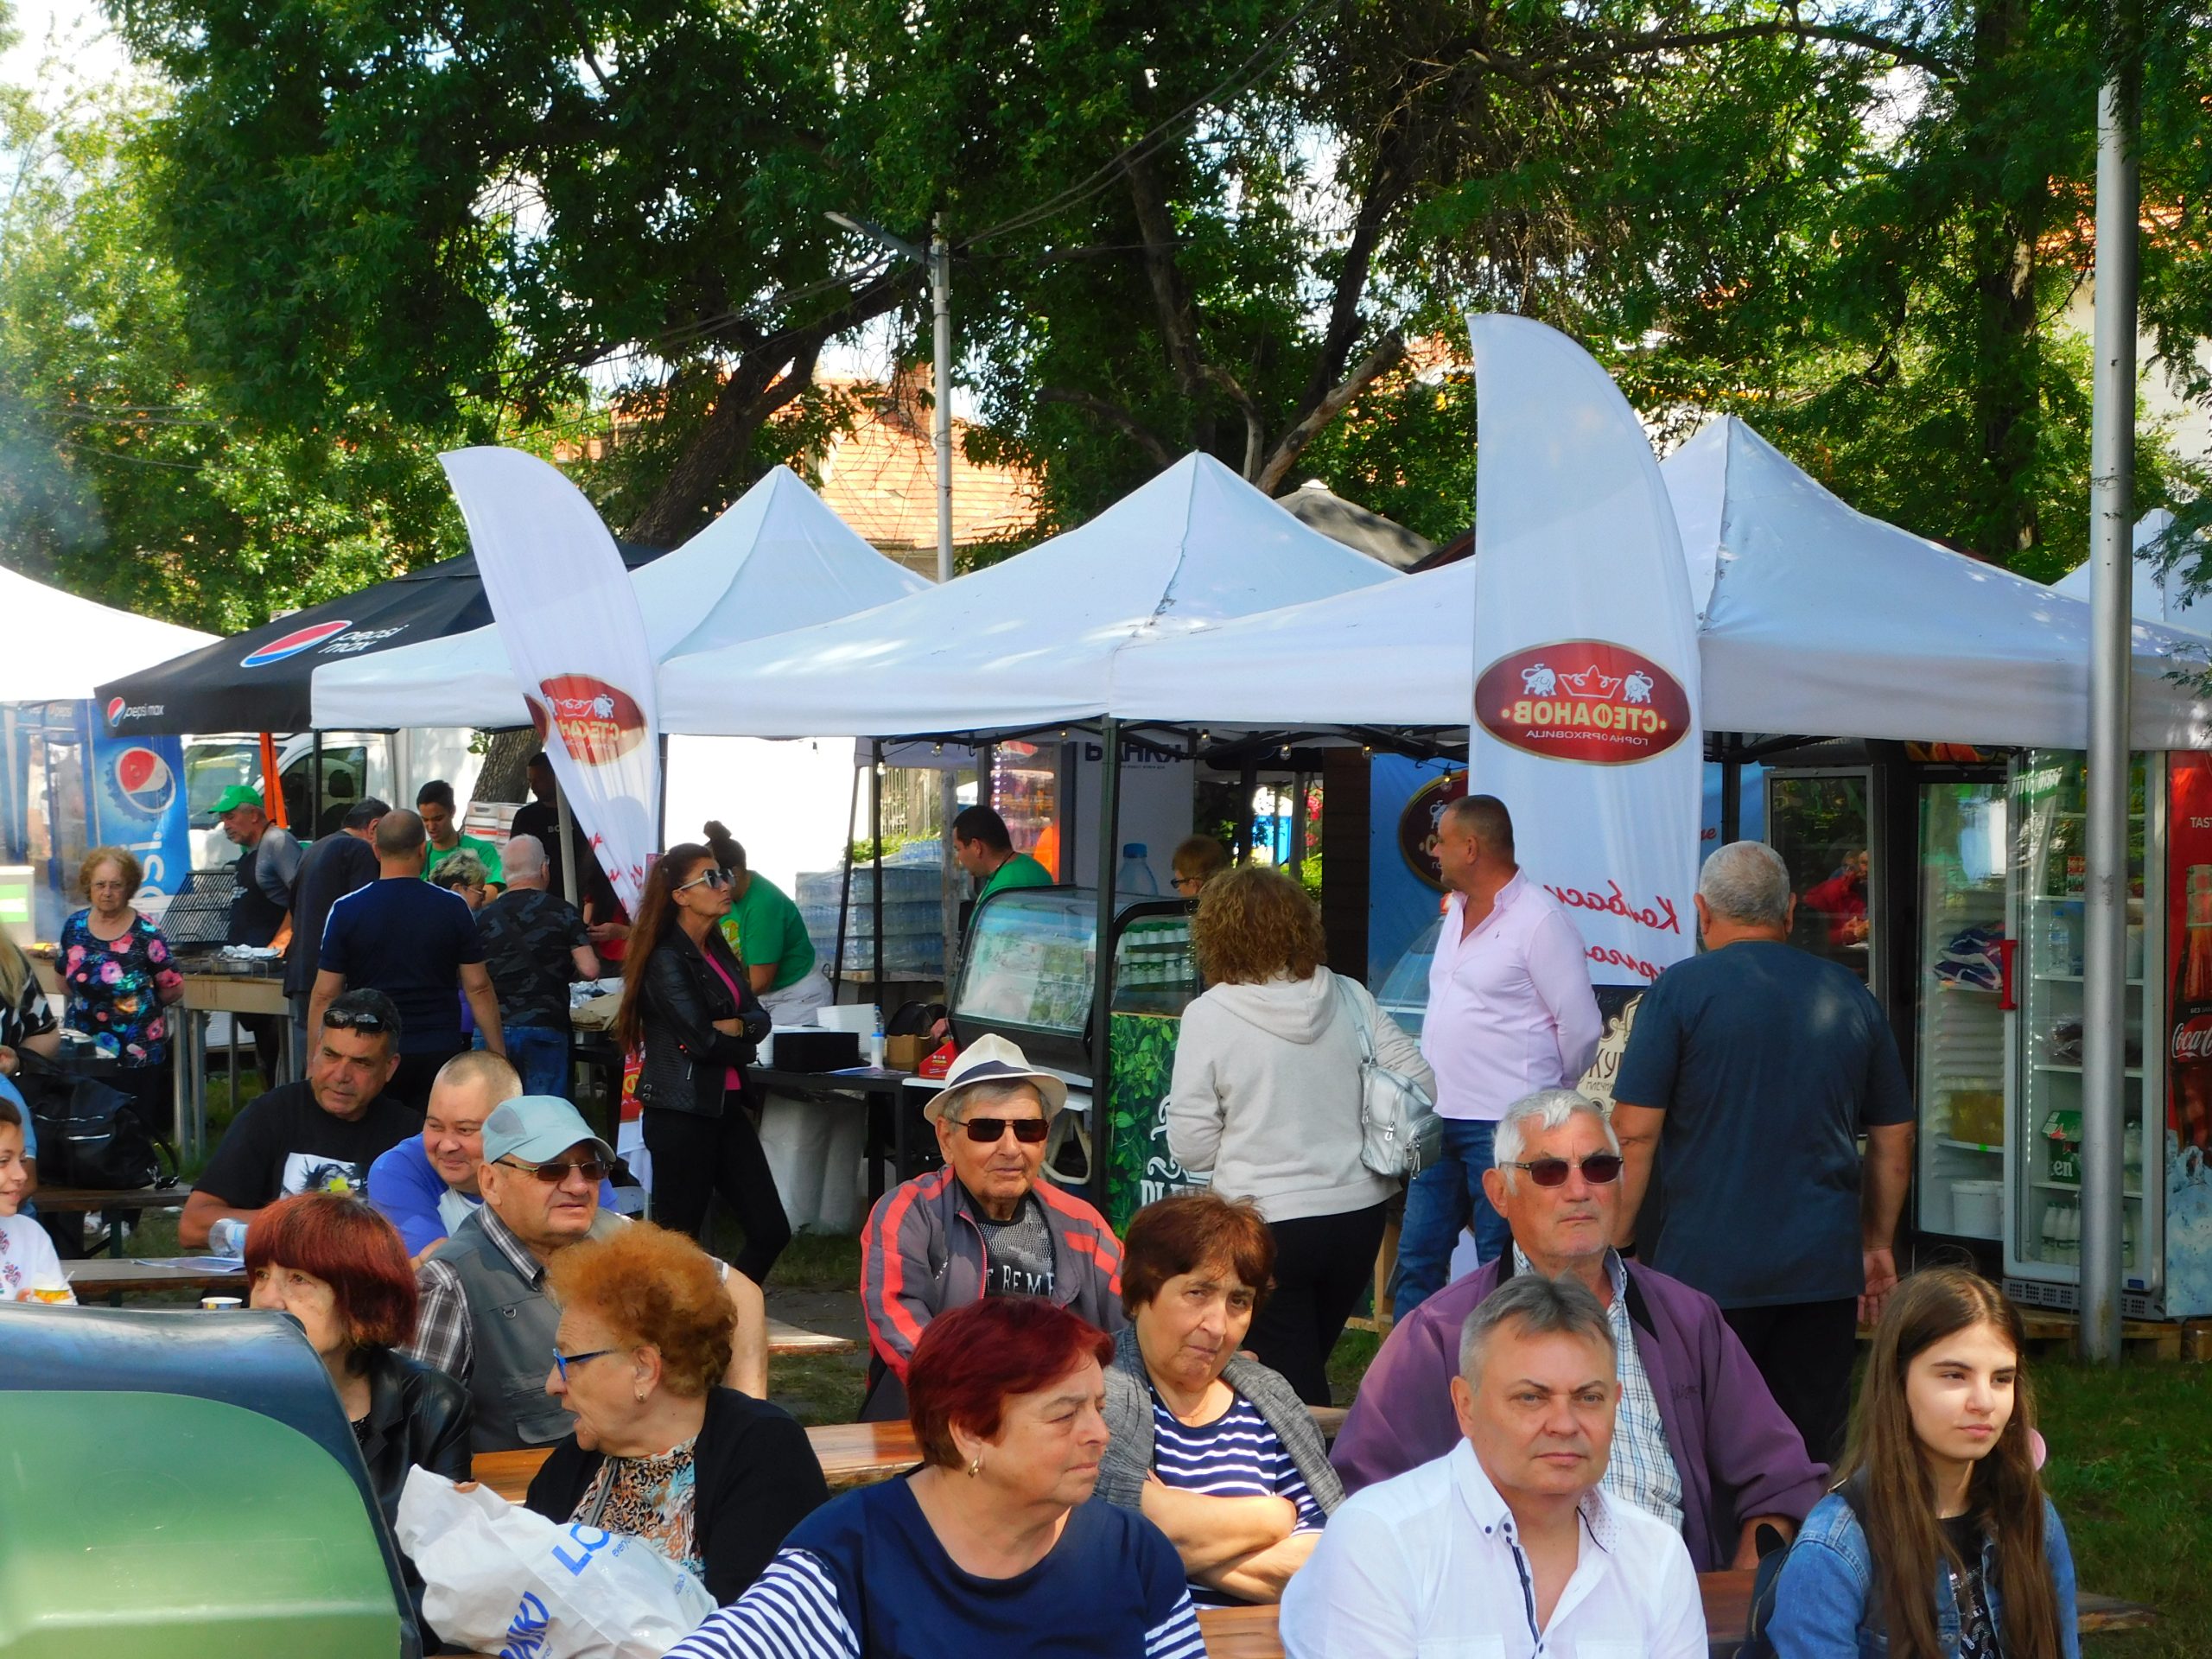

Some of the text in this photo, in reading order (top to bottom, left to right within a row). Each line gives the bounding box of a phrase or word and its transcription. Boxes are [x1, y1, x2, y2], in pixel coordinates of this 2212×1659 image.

[329, 625, 410, 643] pepsi
[318, 640, 378, 654] max
[122, 704, 164, 720] pepsi max
[2190, 817, 2212, 829] TAS
